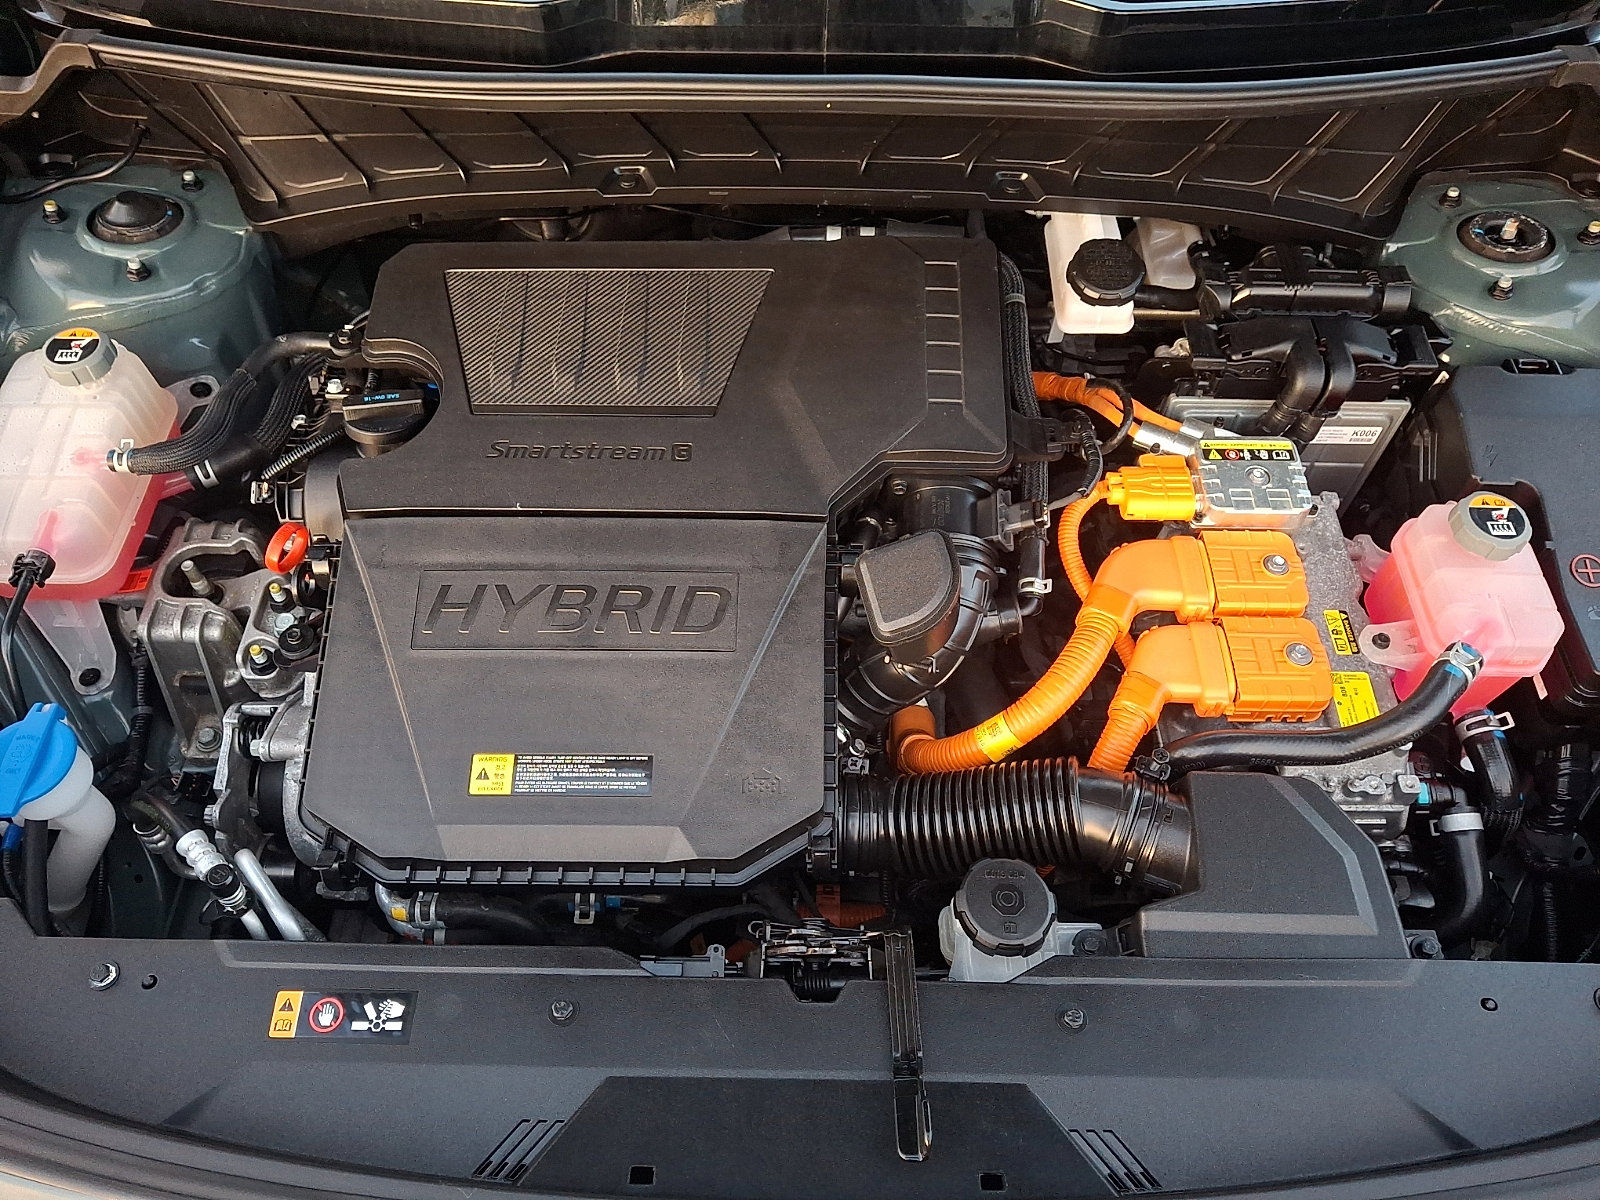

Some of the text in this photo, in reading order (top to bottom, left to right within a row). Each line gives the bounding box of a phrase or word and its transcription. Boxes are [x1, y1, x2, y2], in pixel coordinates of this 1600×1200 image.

[1351, 429, 1378, 437] K006
[486, 439, 667, 460] Smartstream
[421, 583, 733, 635] HYBRID
[1342, 620, 1355, 642] DANGER
